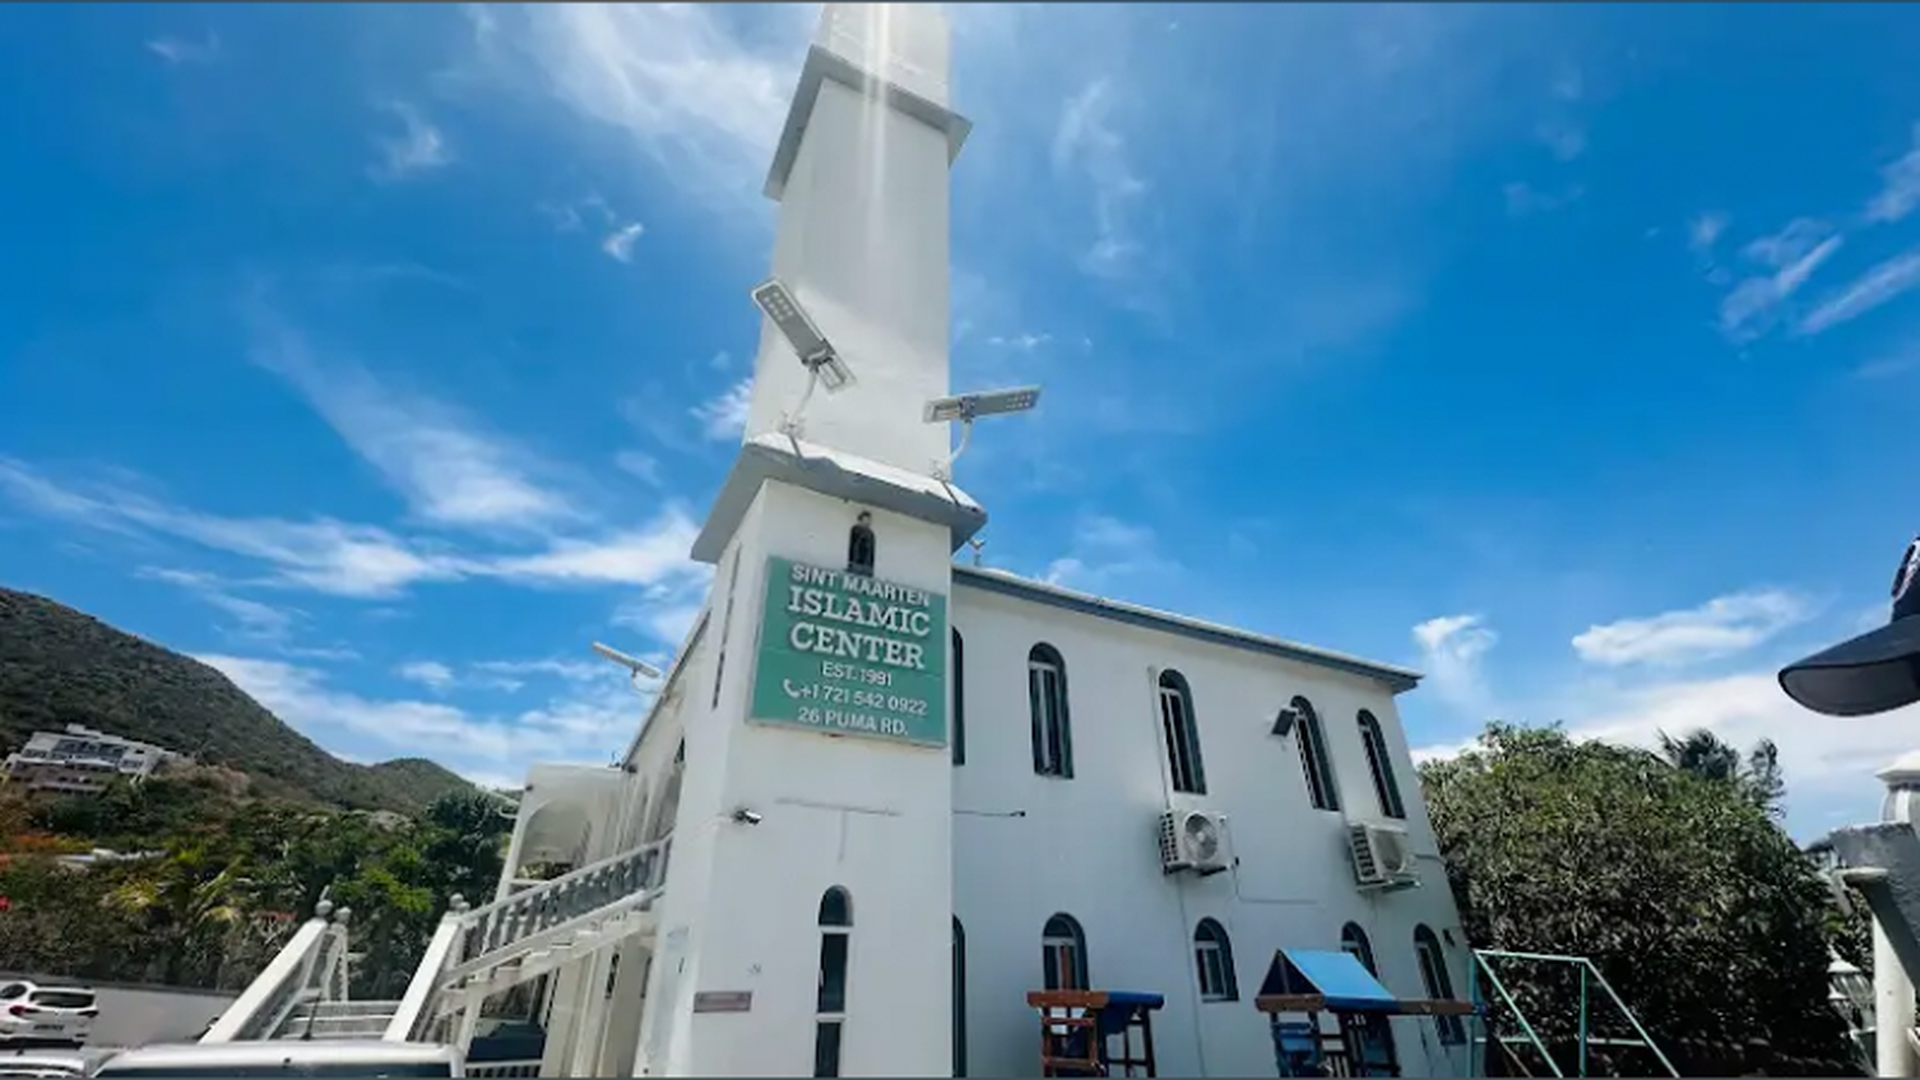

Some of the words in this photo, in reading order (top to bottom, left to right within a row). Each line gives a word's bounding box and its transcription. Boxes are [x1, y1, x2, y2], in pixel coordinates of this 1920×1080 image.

[791, 565, 837, 586] SINT
[842, 575, 930, 607] MAARTEN
[788, 585, 930, 637] ISLAMIC
[790, 621, 925, 669] CENTER
[860, 668, 892, 686] 1991
[800, 684, 818, 699] +1
[824, 686, 850, 701] 721
[853, 690, 884, 708] 542
[887, 694, 928, 715] 0922
[798, 706, 820, 723] 26
[825, 710, 877, 731] PUMA
[881, 718, 909, 736] RD.
